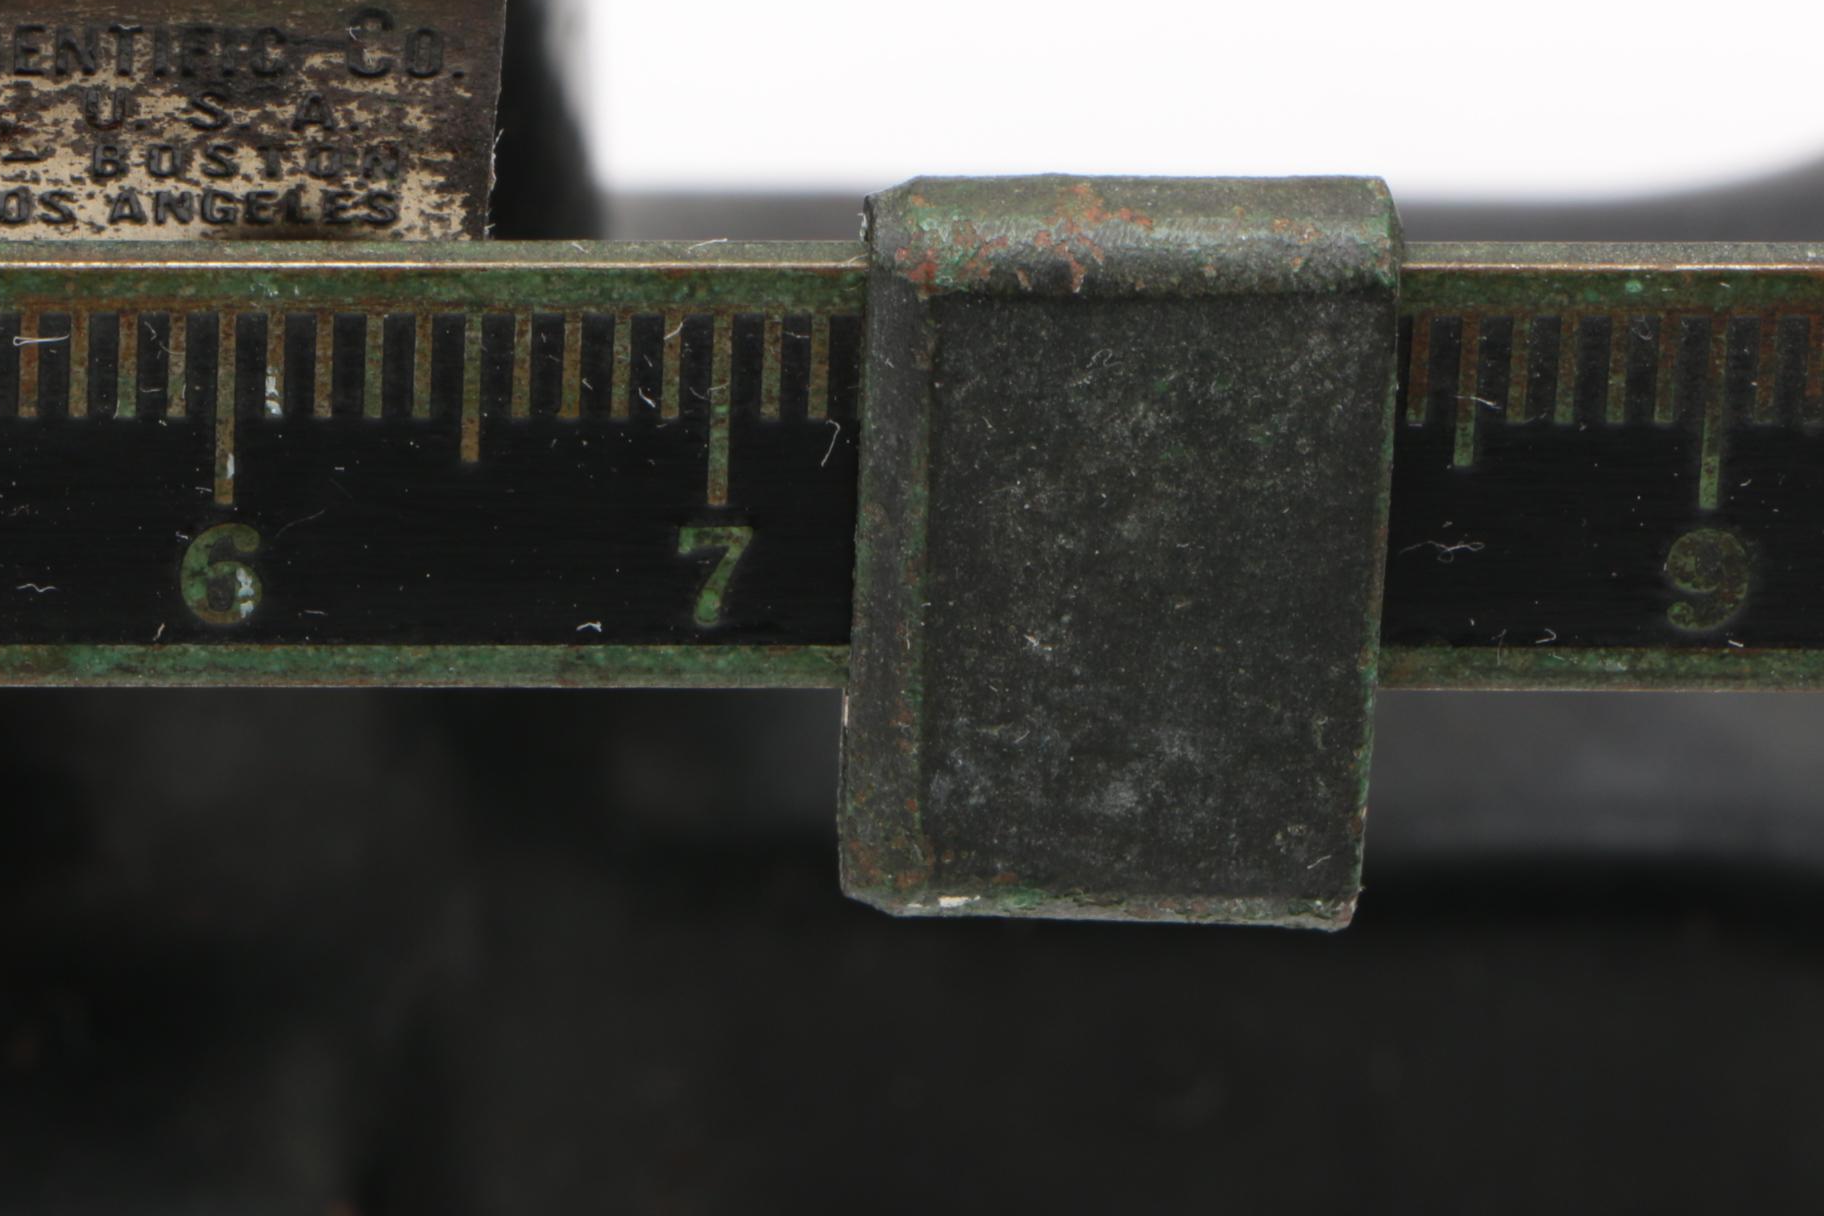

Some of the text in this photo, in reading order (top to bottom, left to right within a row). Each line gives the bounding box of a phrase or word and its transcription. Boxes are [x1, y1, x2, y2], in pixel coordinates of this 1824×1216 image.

[92, 142, 400, 181] BOSTON
[107, 189, 401, 229] ANGELES
[179, 522, 263, 626] 6
[678, 525, 754, 627] 7
[1666, 527, 1749, 632] 9
